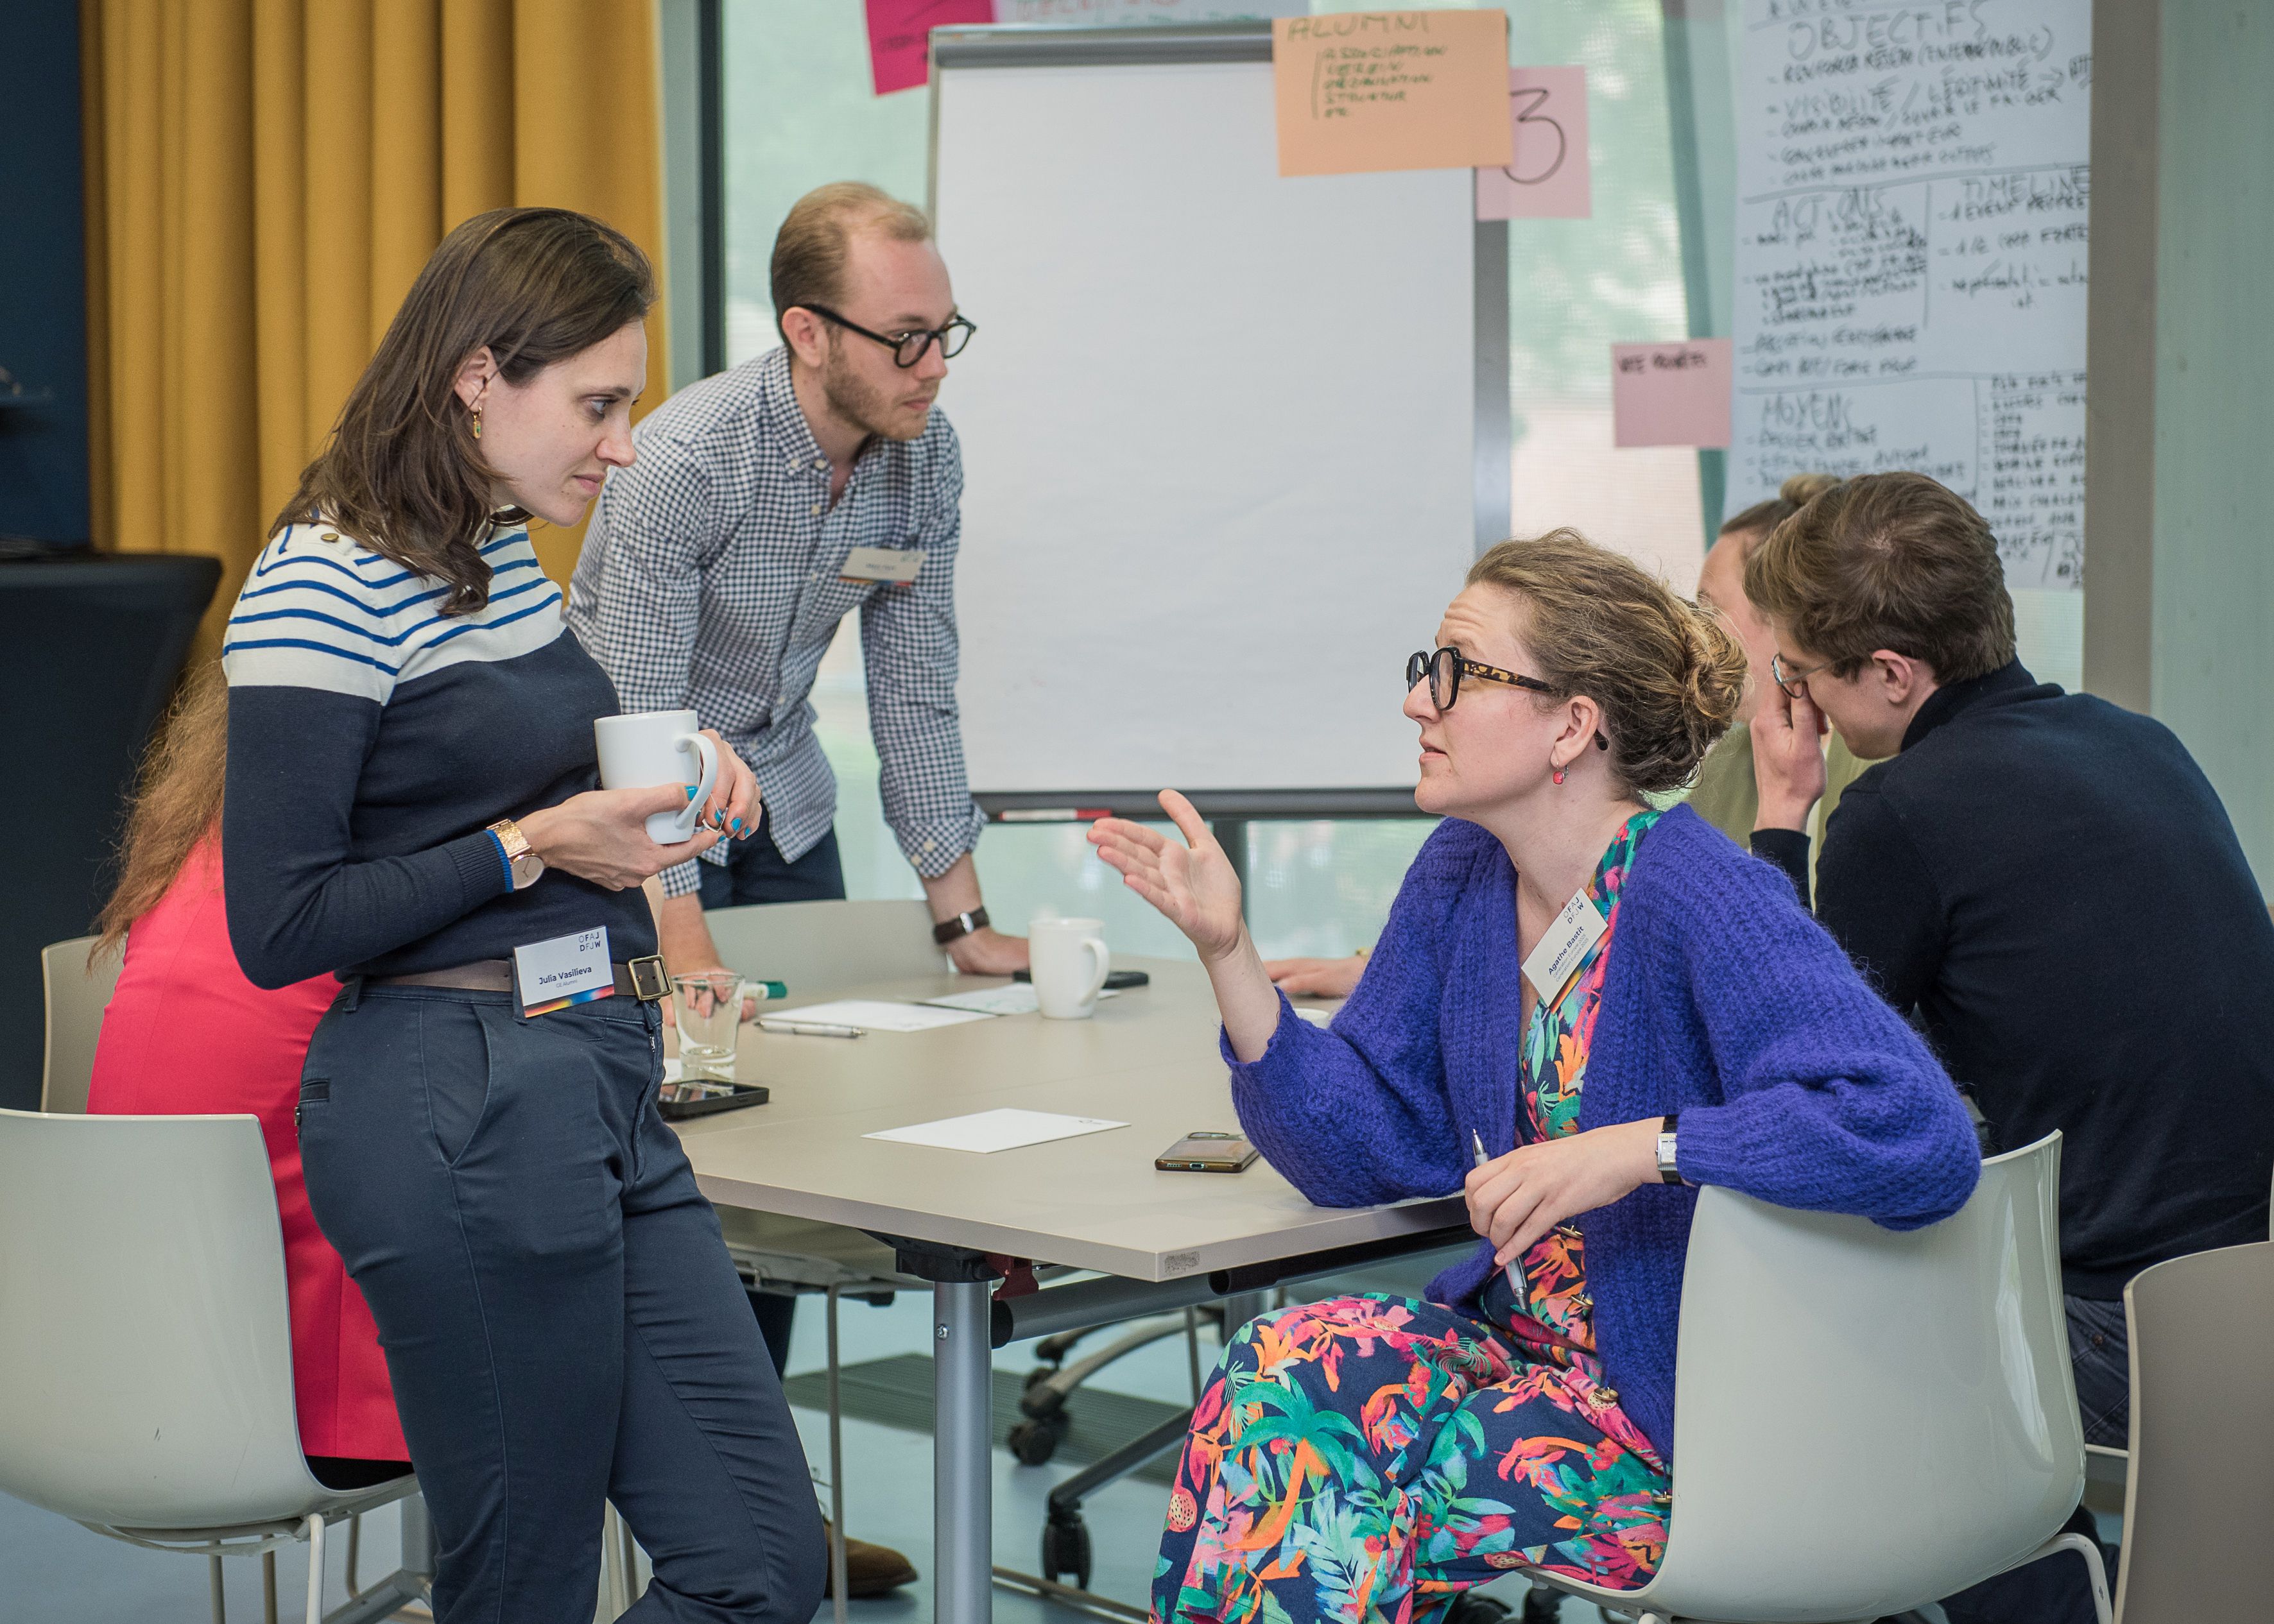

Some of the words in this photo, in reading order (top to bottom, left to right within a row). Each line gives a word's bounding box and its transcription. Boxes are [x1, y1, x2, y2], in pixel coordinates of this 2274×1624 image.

[1288, 12, 1430, 42] ALUMNI
[1788, 0, 1988, 61] OBJECTIFS
[1323, 44, 1448, 59] ASSOCIATION
[1503, 87, 1566, 185] 3
[1961, 166, 2090, 201] TIMELINE
[1762, 389, 1852, 432] MOYENS
[1563, 896, 1580, 918] OFAJ
[1567, 902, 1584, 924] DFJW
[578, 932, 599, 943] OFAJ
[580, 940, 601, 952] DFJW
[1548, 948, 1567, 975] Agathe
[1567, 926, 1584, 948] Bastit
[538, 975, 556, 985] Julia
[558, 967, 592, 979] Vasilieva
